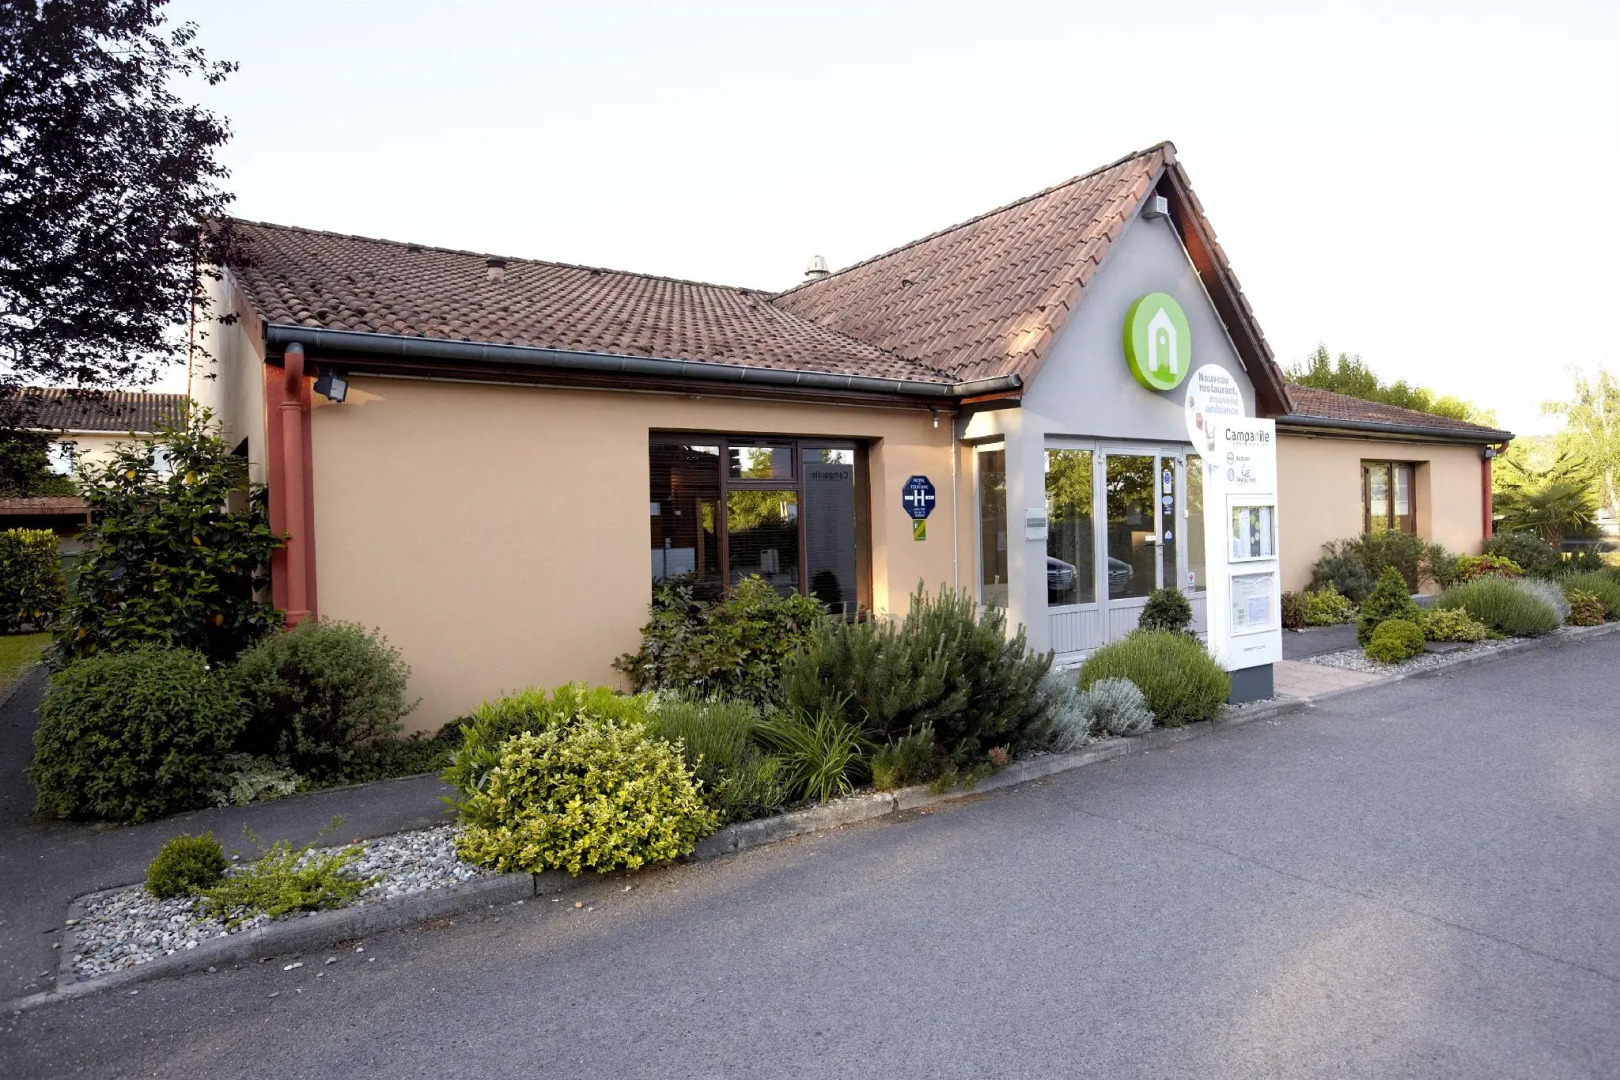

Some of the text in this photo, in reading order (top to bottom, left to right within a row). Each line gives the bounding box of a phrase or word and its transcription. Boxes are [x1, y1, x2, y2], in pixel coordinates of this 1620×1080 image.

[1198, 372, 1229, 384] Nouveau
[1199, 384, 1238, 396] restaurant,
[1205, 404, 1239, 415] ambiance
[1225, 428, 1270, 445] Campanile
[914, 489, 926, 506] H
